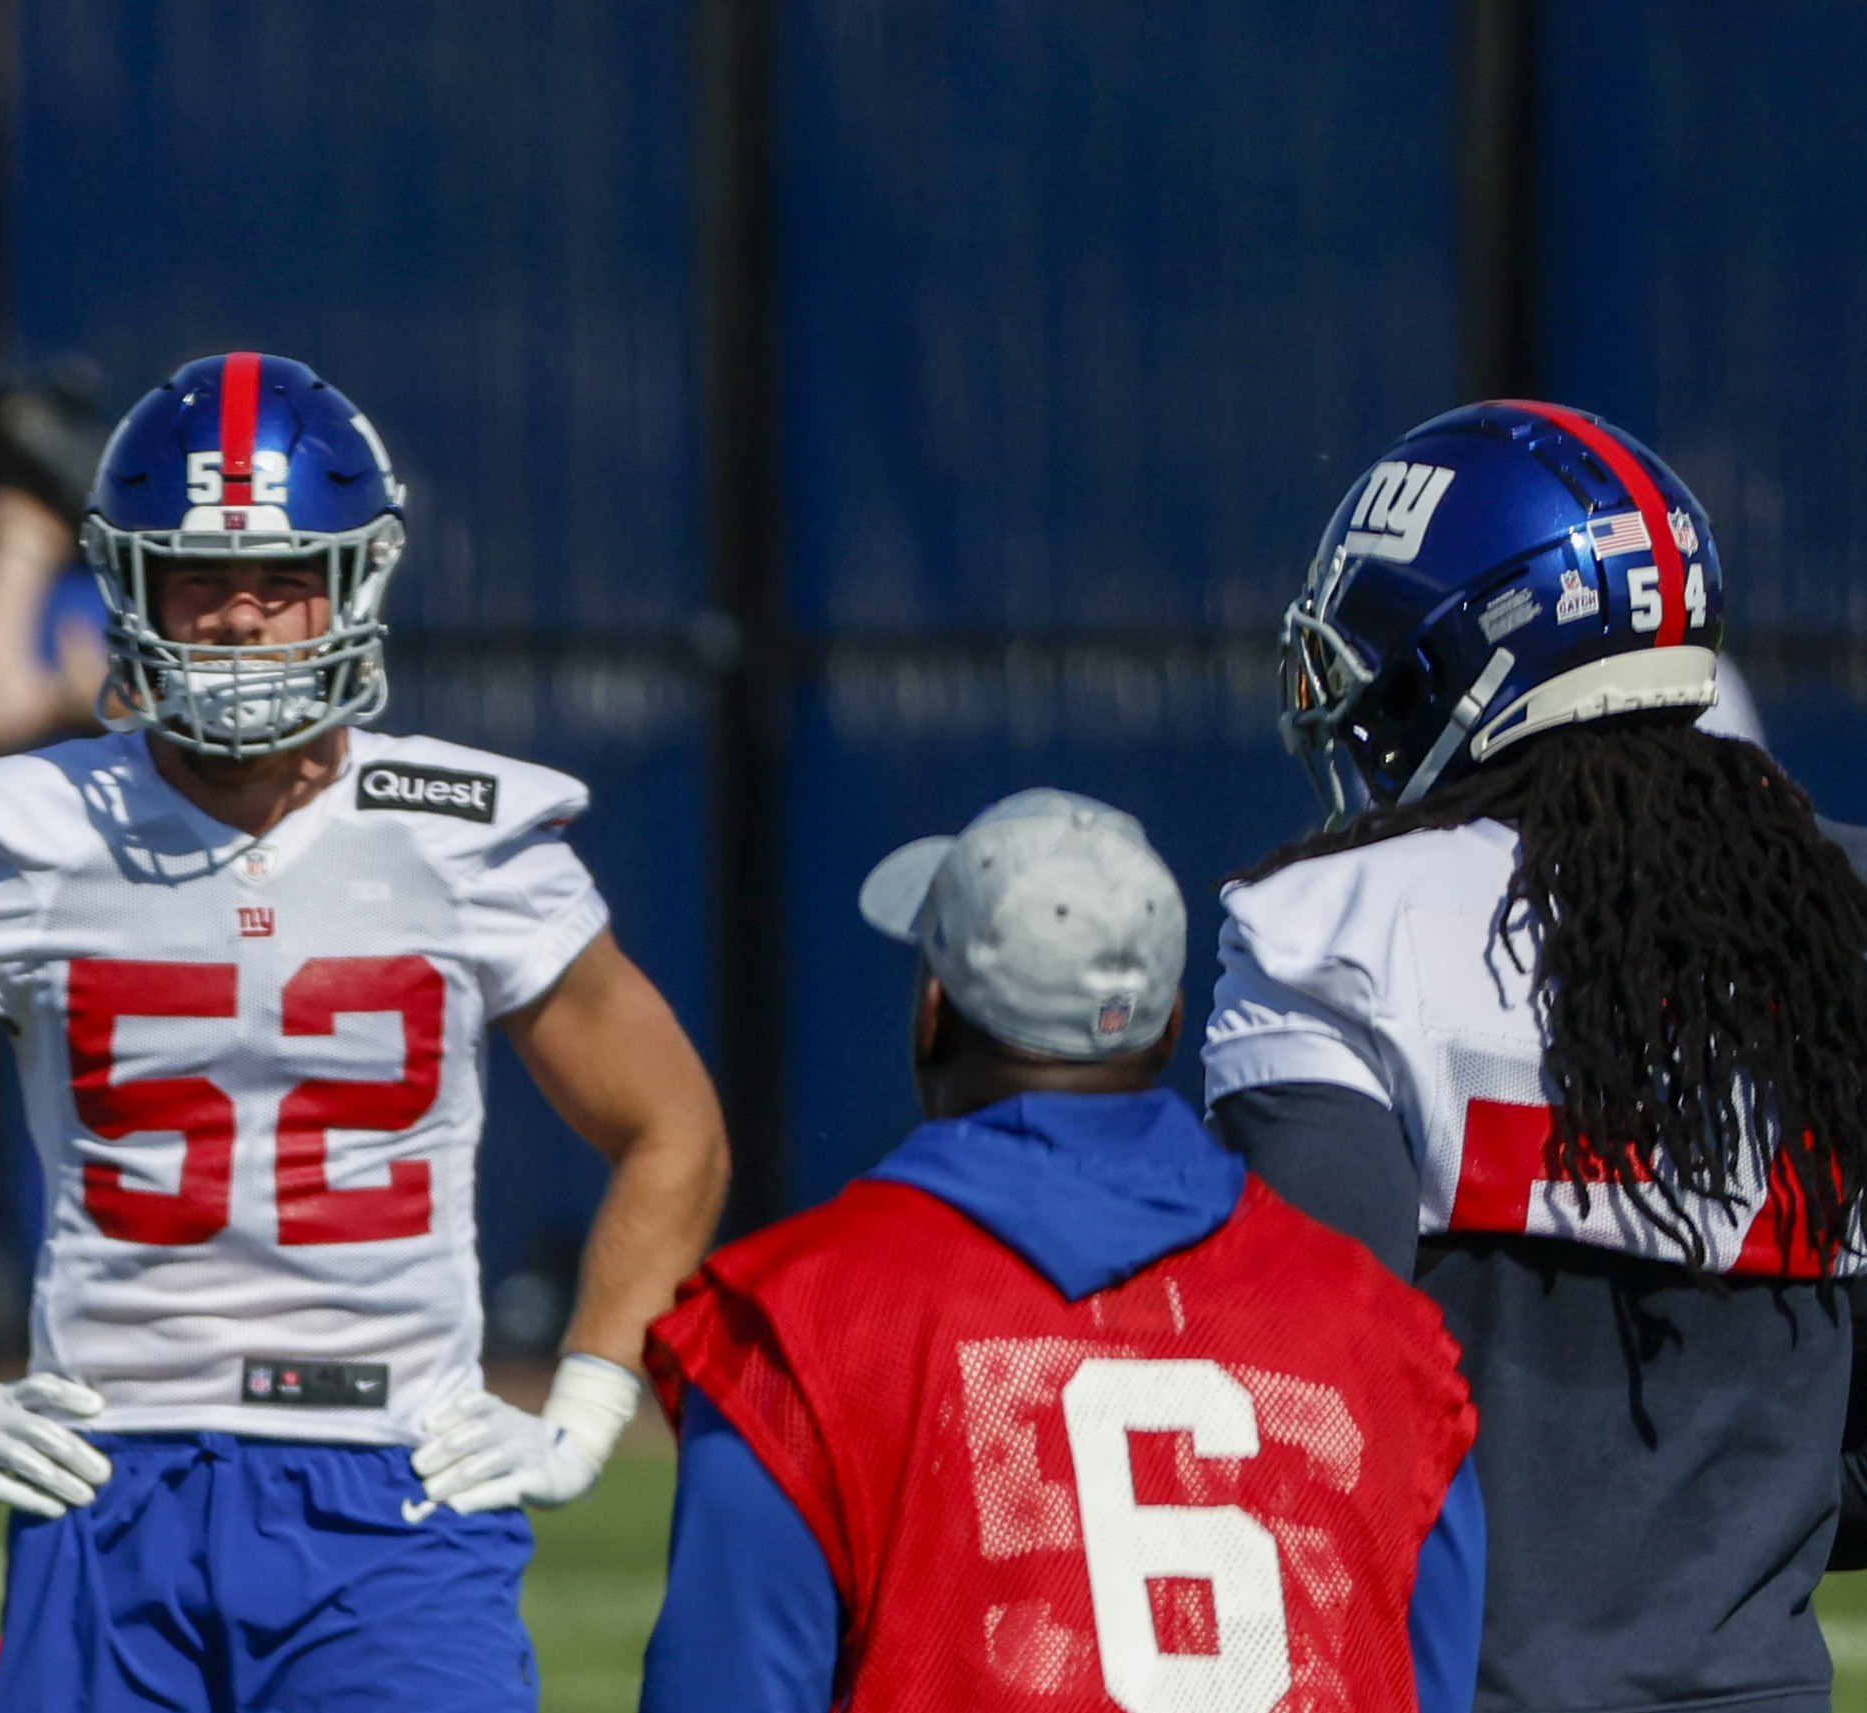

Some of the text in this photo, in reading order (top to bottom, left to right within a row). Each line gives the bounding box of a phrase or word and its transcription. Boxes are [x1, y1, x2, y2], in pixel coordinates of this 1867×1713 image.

[186, 450, 288, 504] 52
[1344, 460, 1454, 563] ny
[1627, 563, 1706, 633] 54
[363, 769, 489, 811] Quest
[237, 906, 275, 937] ny
[68, 954, 446, 1247] 52
